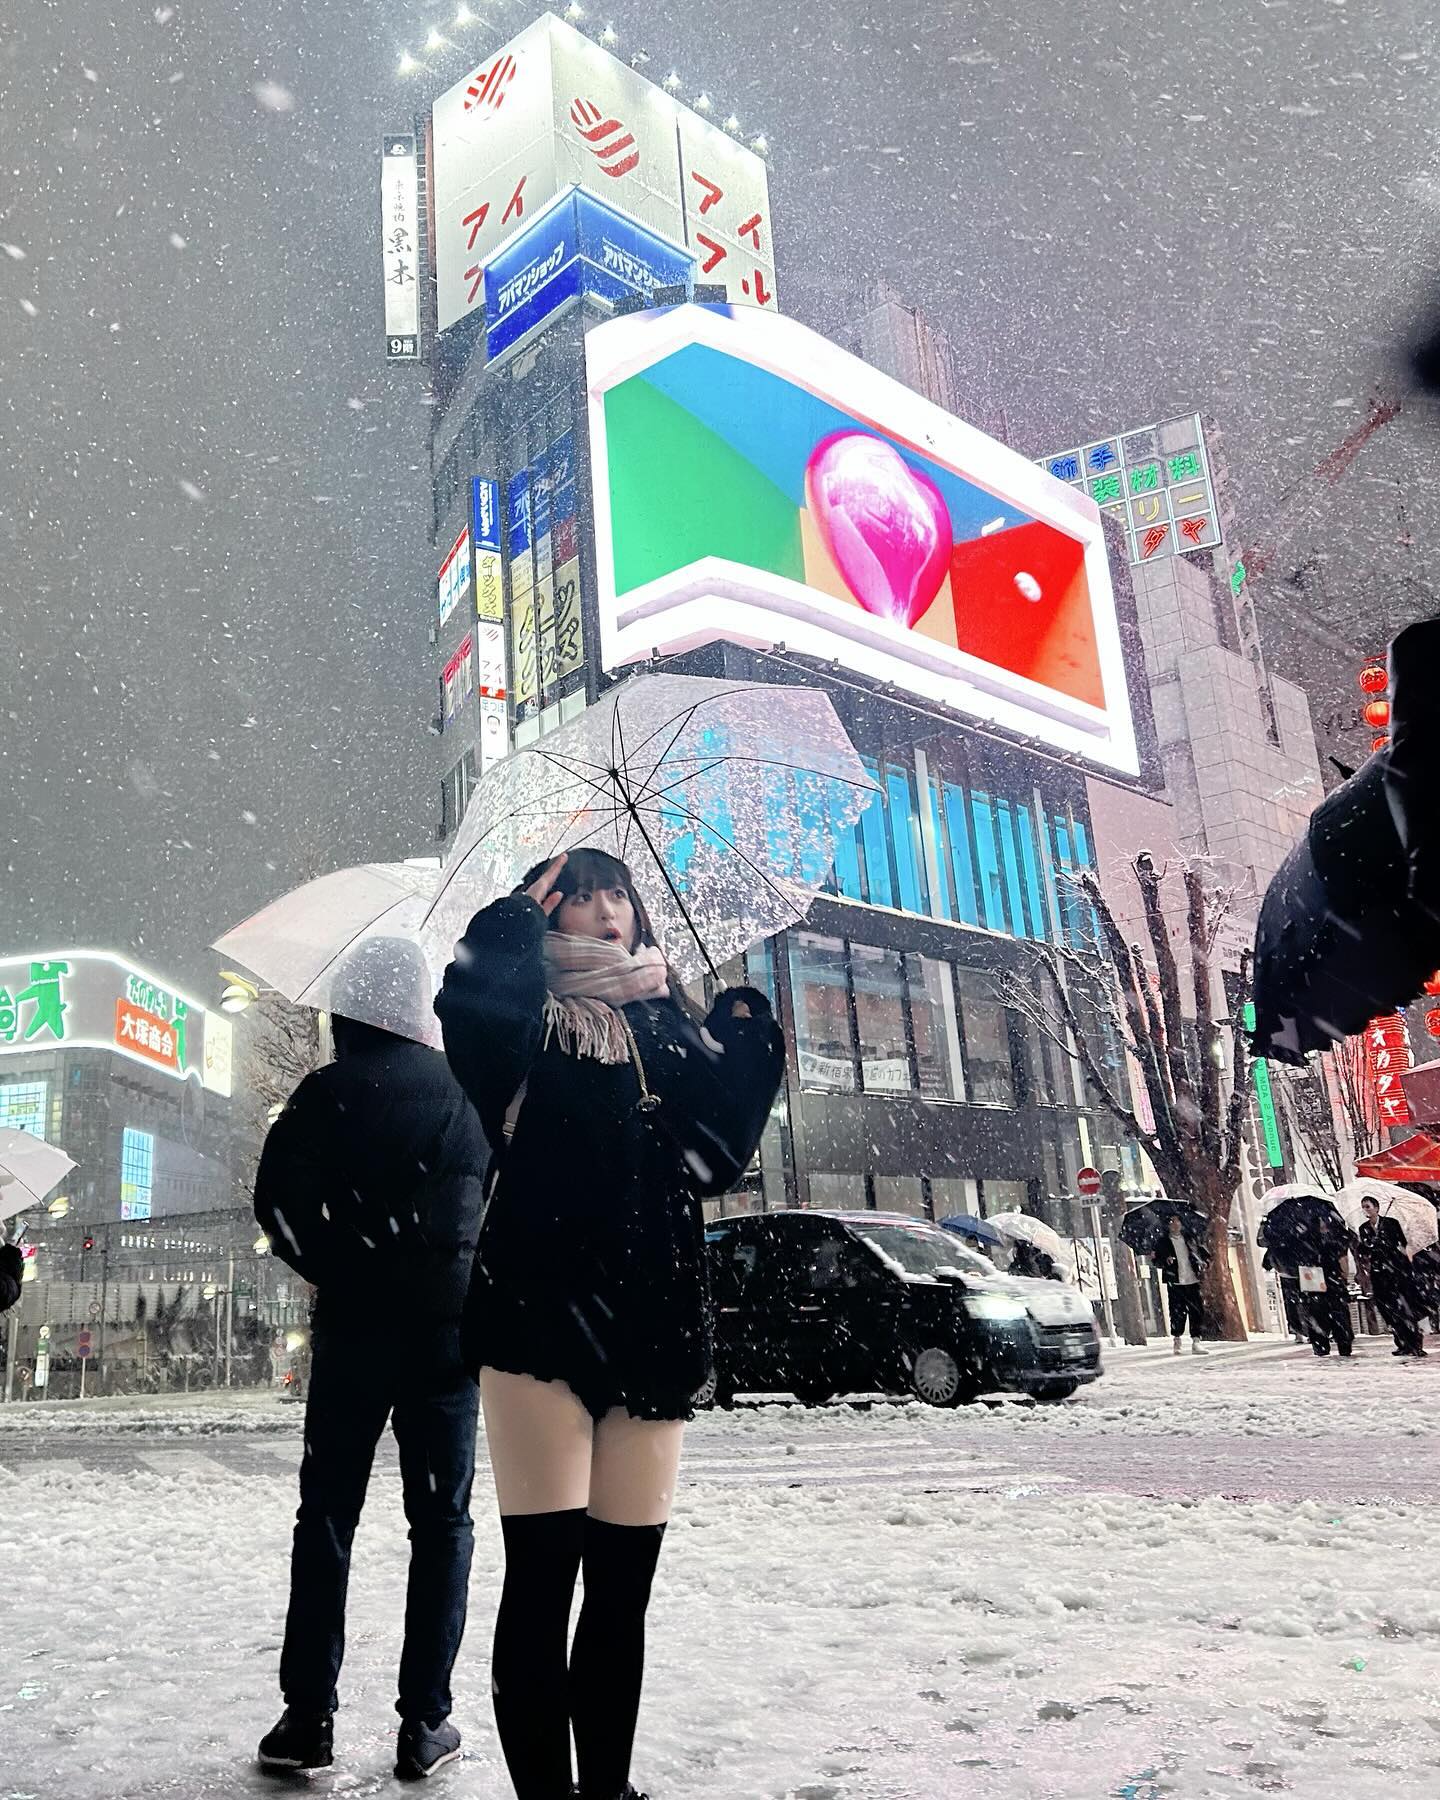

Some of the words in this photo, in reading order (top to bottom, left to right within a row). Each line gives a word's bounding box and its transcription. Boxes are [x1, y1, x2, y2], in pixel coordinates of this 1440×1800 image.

[462, 175, 528, 250] アイ
[691, 171, 762, 250] アイ
[386, 227, 415, 286] 黒木
[498, 241, 565, 313] アパマンショップ
[603, 244, 664, 289] アパマンショ
[696, 232, 772, 305] フル
[390, 338, 414, 354] 9階
[121, 1012, 173, 1058] 大塚商会
[1259, 1076, 1268, 1098] MOA
[1266, 1115, 1276, 1152] Avenue
